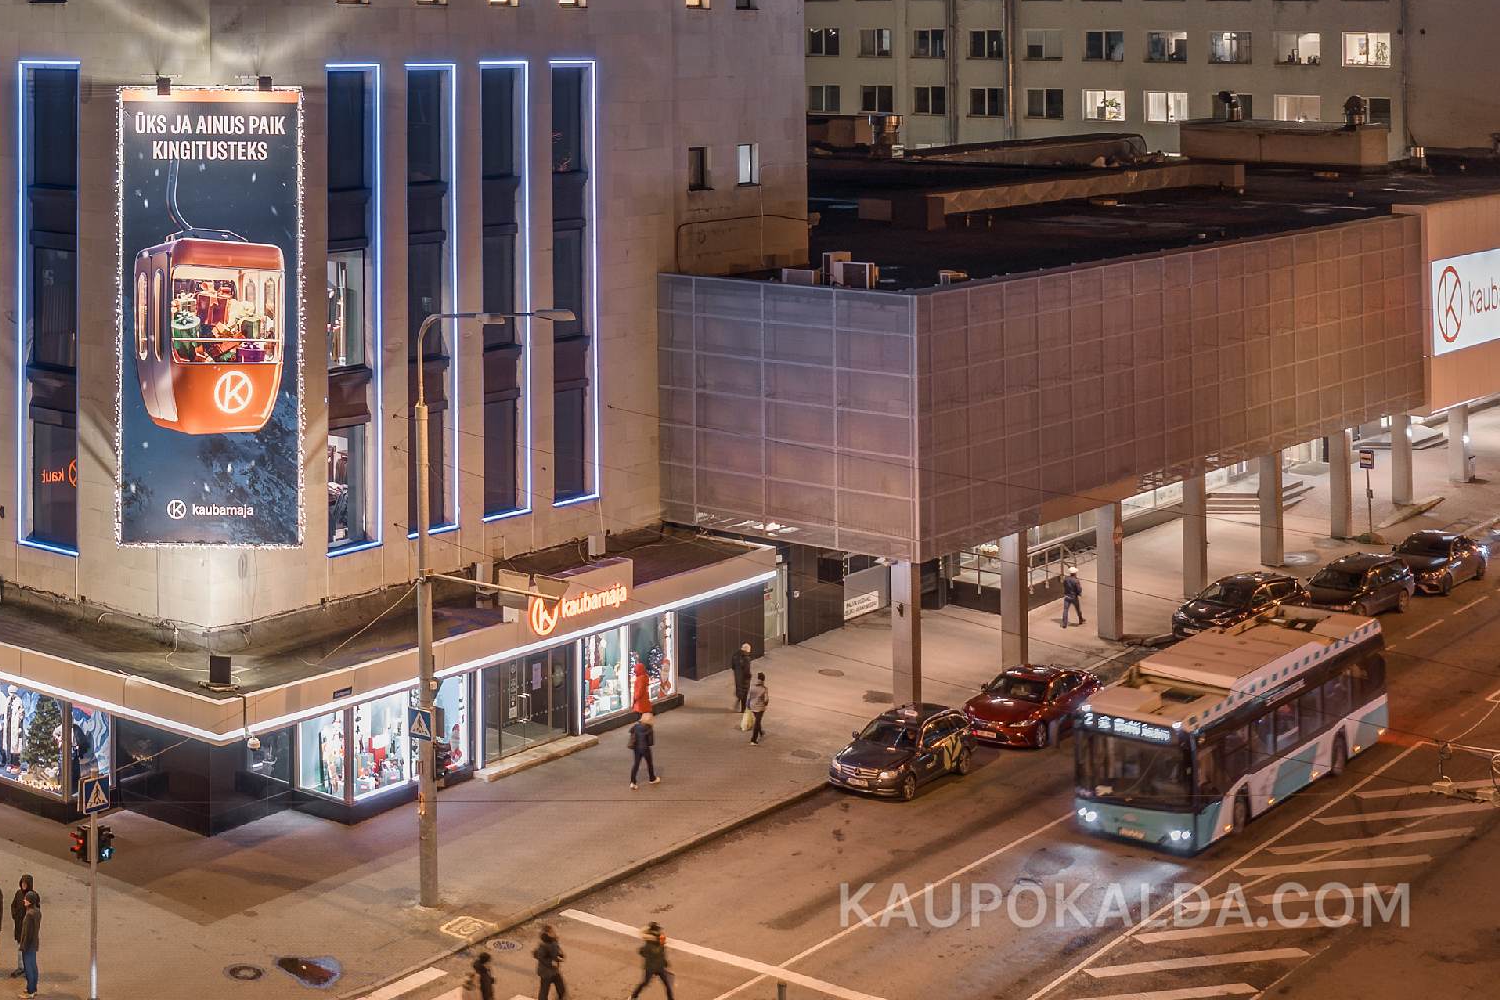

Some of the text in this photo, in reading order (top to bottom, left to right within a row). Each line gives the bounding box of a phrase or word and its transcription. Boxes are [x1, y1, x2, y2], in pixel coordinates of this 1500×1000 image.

[135, 111, 286, 135] ÜKS JA AINUS PAIK
[152, 140, 268, 161] KINGITUSTEKS
[192, 503, 254, 518] kaubamaja
[561, 582, 628, 619] kaubamaja
